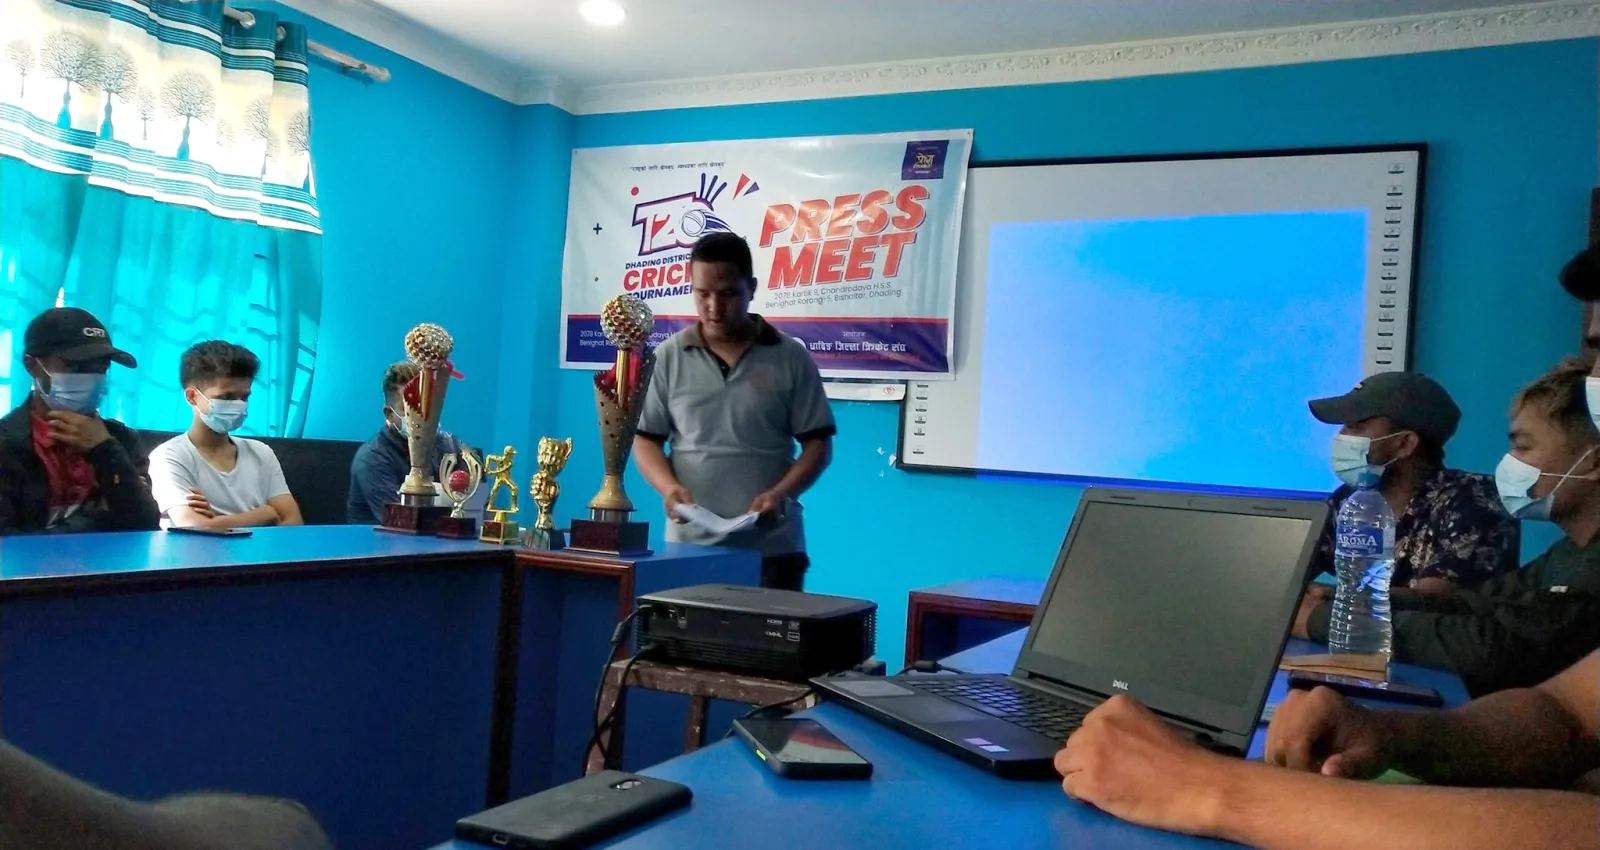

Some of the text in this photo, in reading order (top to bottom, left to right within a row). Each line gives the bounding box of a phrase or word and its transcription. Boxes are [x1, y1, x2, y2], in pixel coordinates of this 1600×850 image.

[759, 184, 930, 248] PRESS
[625, 253, 692, 270] DHADING DISTRIC
[768, 231, 918, 290] MEET
[623, 261, 692, 291] CRIC
[765, 298, 797, 309] Benighat
[869, 288, 902, 299] Dhading
[775, 291, 791, 300] 2078
[792, 289, 812, 299] Kartik
[821, 283, 872, 296] Chandrodaya
[834, 341, 860, 352] जिल्ला
[1338, 533, 1378, 547] AROMA
[1112, 679, 1128, 691] DELL
